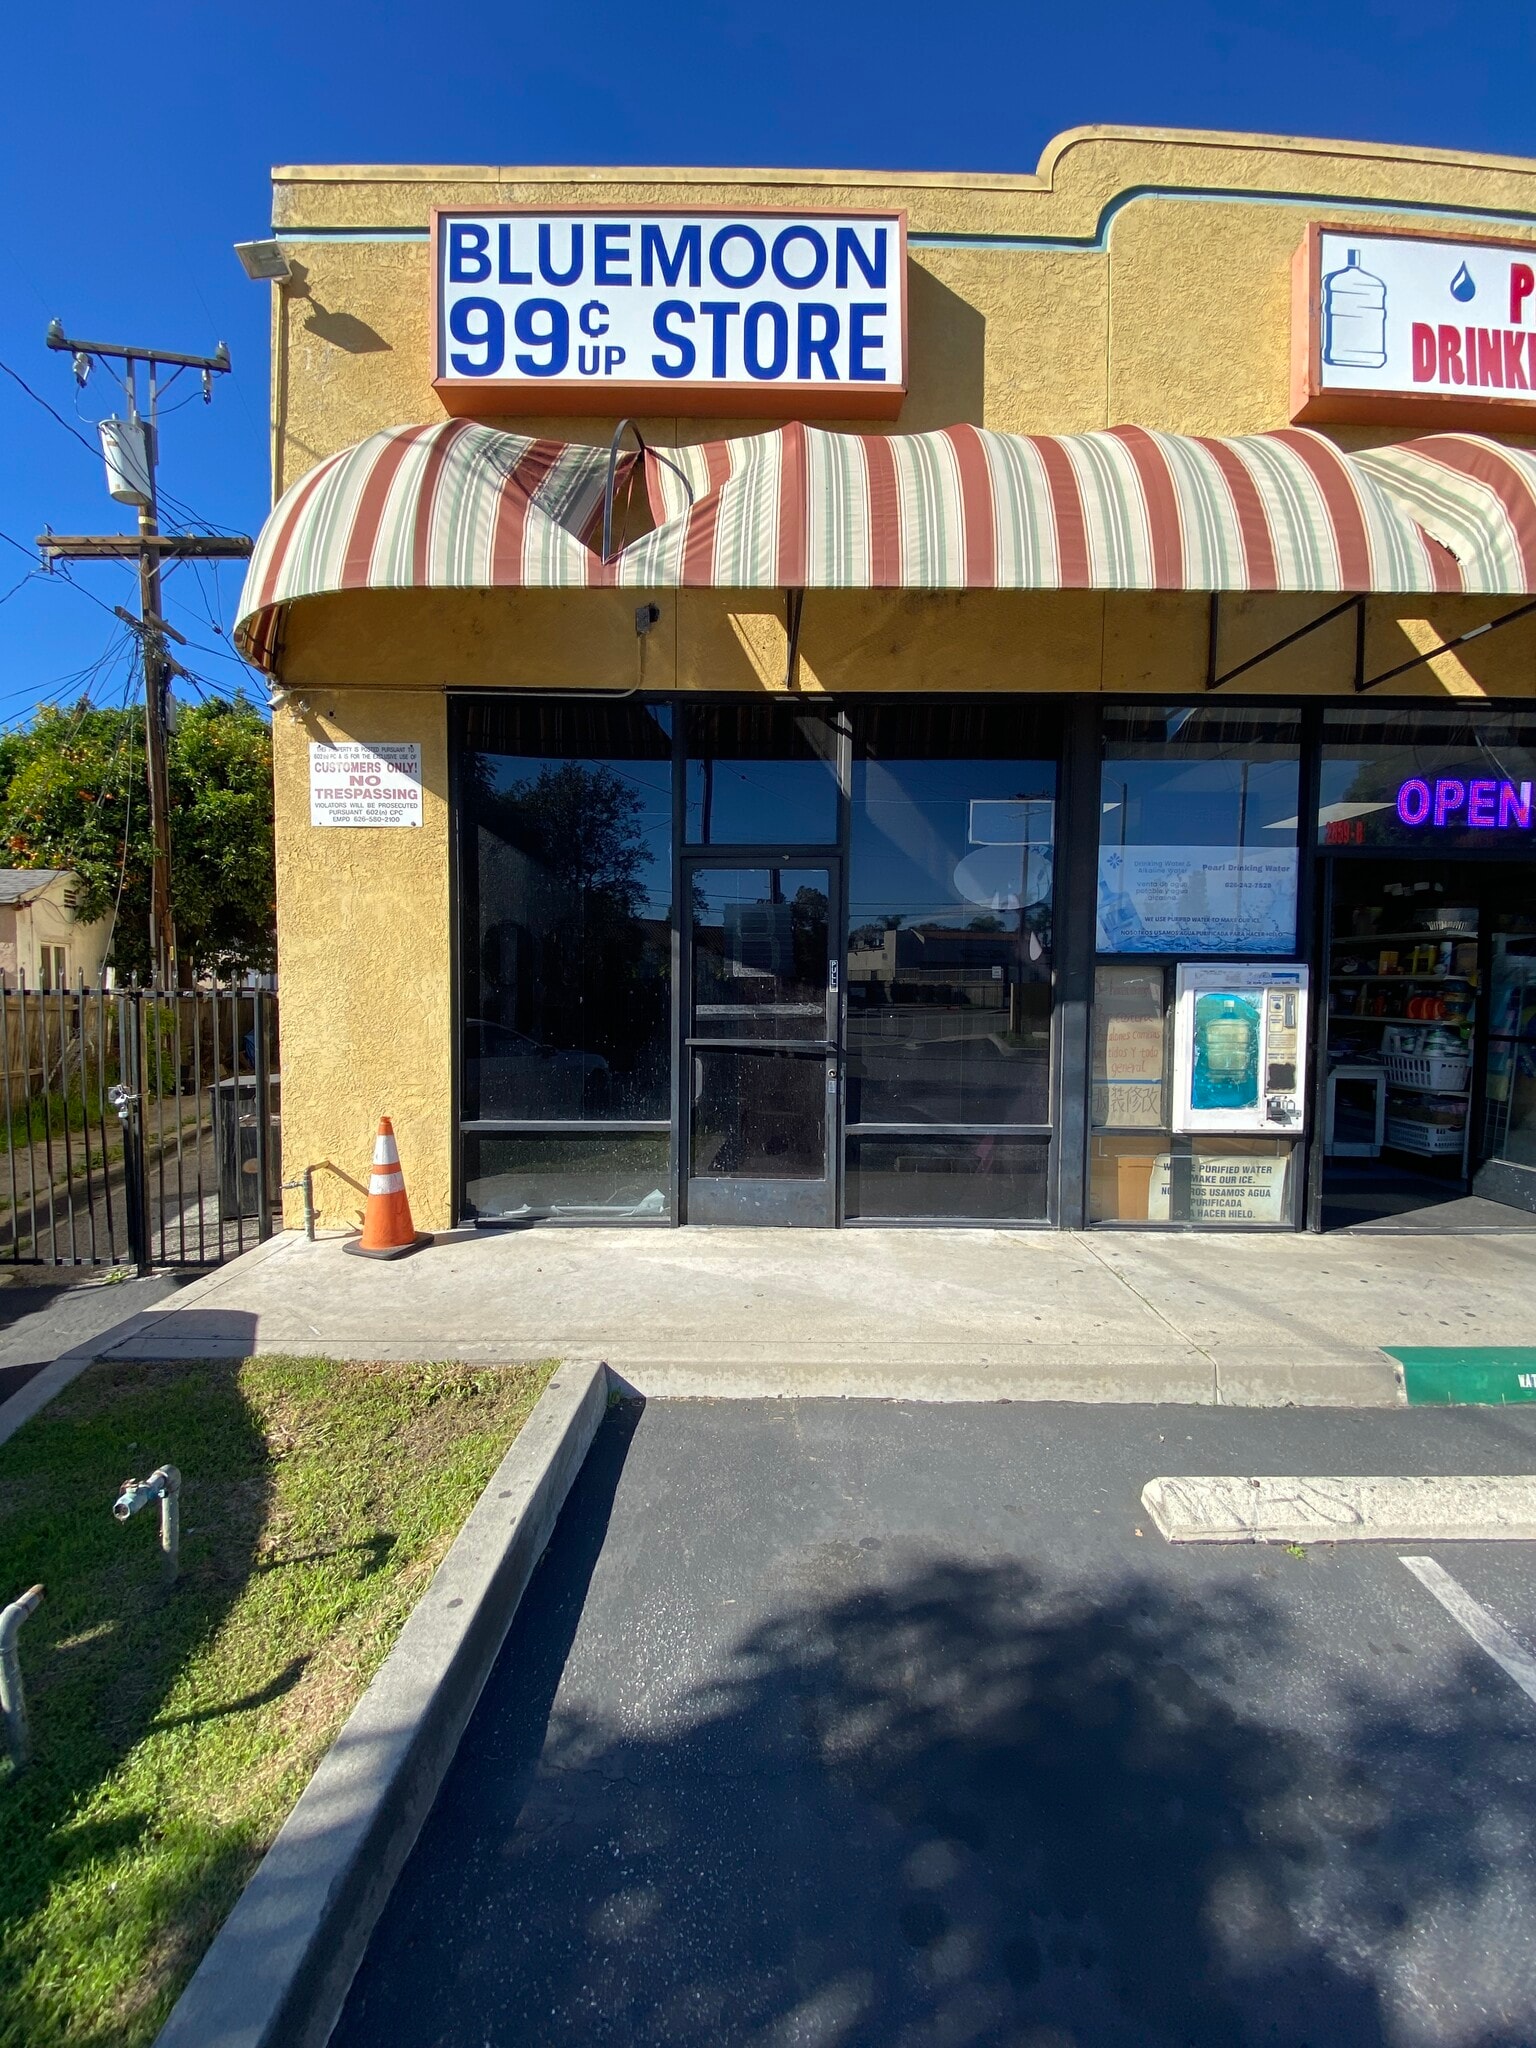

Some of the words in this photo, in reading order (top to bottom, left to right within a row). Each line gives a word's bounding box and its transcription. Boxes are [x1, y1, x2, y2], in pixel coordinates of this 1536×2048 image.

[448, 222, 888, 290] BLUEMOON
[578, 345, 627, 376] UP
[651, 299, 888, 382] STORE
[314, 761, 382, 774] CUSTOMERS
[386, 761, 418, 774] ONLY!
[349, 775, 382, 787] NO
[314, 788, 419, 800] TRESPASSING
[1396, 778, 1534, 828] OPEN
[1202, 864, 1226, 872] Pearl
[1227, 864, 1263, 873] Drinking
[1265, 865, 1291, 873] Water
[1199, 1164, 1240, 1174] PURIFIED
[1242, 1166, 1273, 1174] WATER
[1191, 1174, 1217, 1184] MAKE
[1219, 1175, 1237, 1184] OUR
[1238, 1176, 1256, 1184] ICE.
[1209, 1188, 1246, 1197] USAMOS
[1247, 1188, 1272, 1198] AGUA
[1191, 1198, 1243, 1208] PURIFICADA
[1197, 1209, 1227, 1218] HACER
[1228, 1209, 1257, 1219] HIELO.
